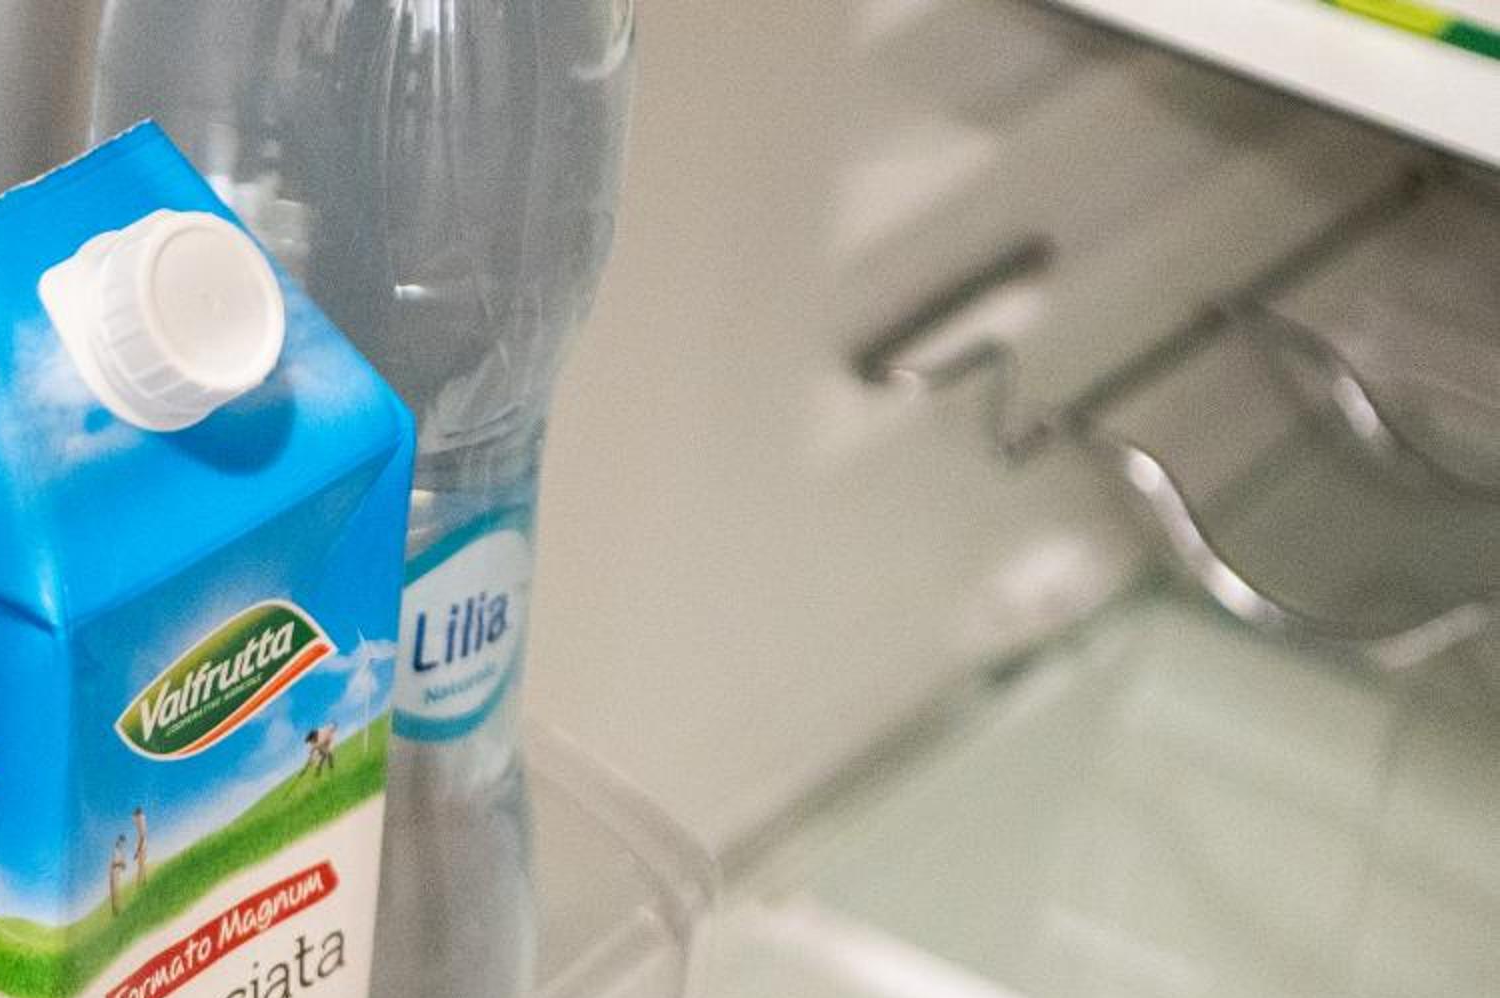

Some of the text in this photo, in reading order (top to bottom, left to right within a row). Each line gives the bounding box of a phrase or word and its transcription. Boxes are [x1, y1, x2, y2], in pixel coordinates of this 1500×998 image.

[413, 591, 509, 672] Lilia
[139, 620, 295, 742] Valfrutta
[218, 867, 324, 950] Magnum
